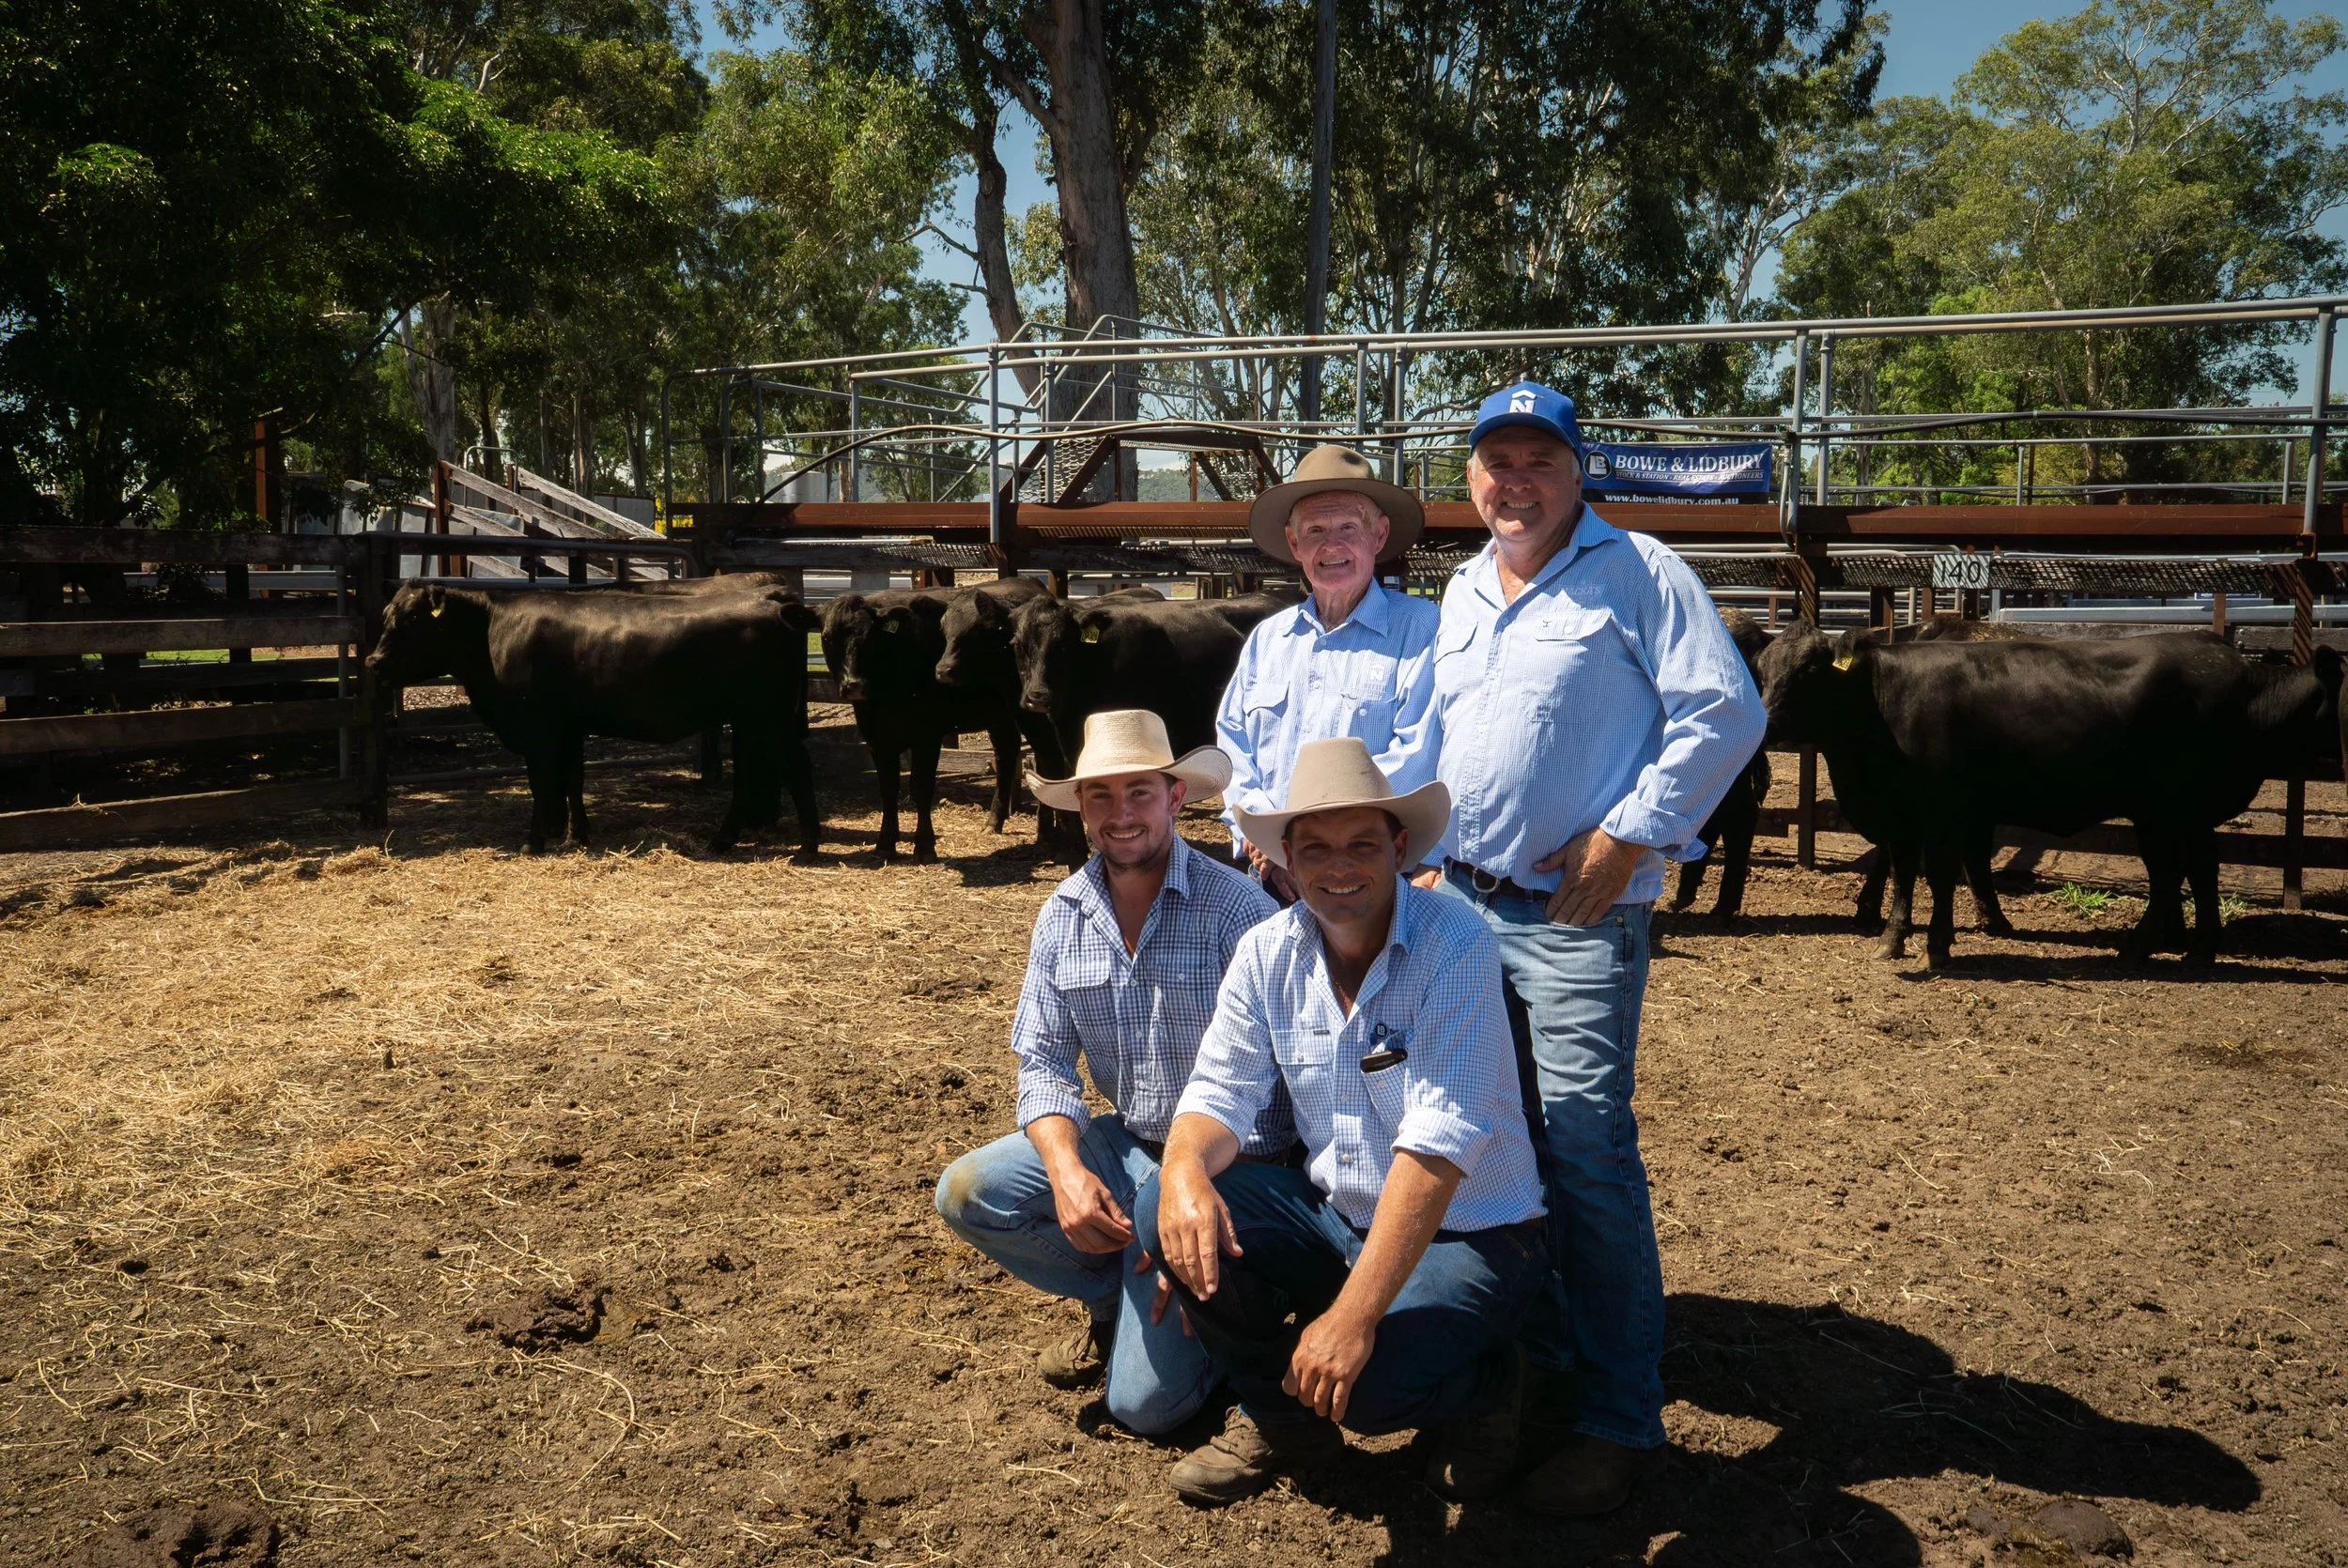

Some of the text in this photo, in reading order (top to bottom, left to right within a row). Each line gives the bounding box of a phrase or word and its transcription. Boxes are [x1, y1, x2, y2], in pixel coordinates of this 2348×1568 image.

[1614, 453, 1765, 472] BOWE & LIDBURY
[1718, 471, 1764, 481] AUCTIONEERS
[1604, 494, 1739, 505] www.bowelidbury.com.au
[1941, 561, 1982, 583] 140
